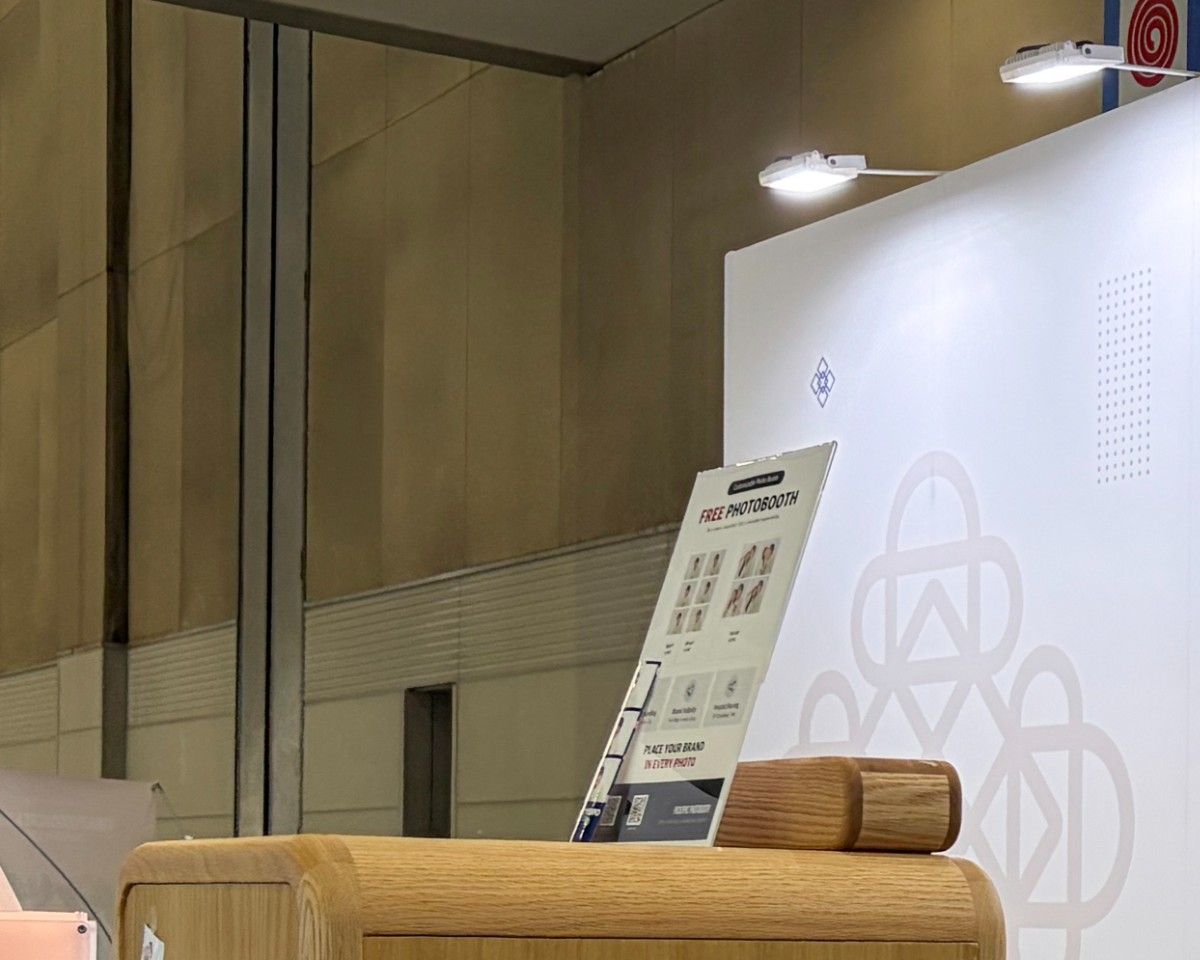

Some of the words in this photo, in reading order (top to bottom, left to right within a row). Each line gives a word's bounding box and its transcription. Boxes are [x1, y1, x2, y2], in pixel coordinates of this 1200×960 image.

[699, 506, 726, 524] FREE
[725, 490, 800, 519] PHOTOBOOTH
[664, 743, 682, 753] YOUR
[682, 741, 705, 752] BRAND
